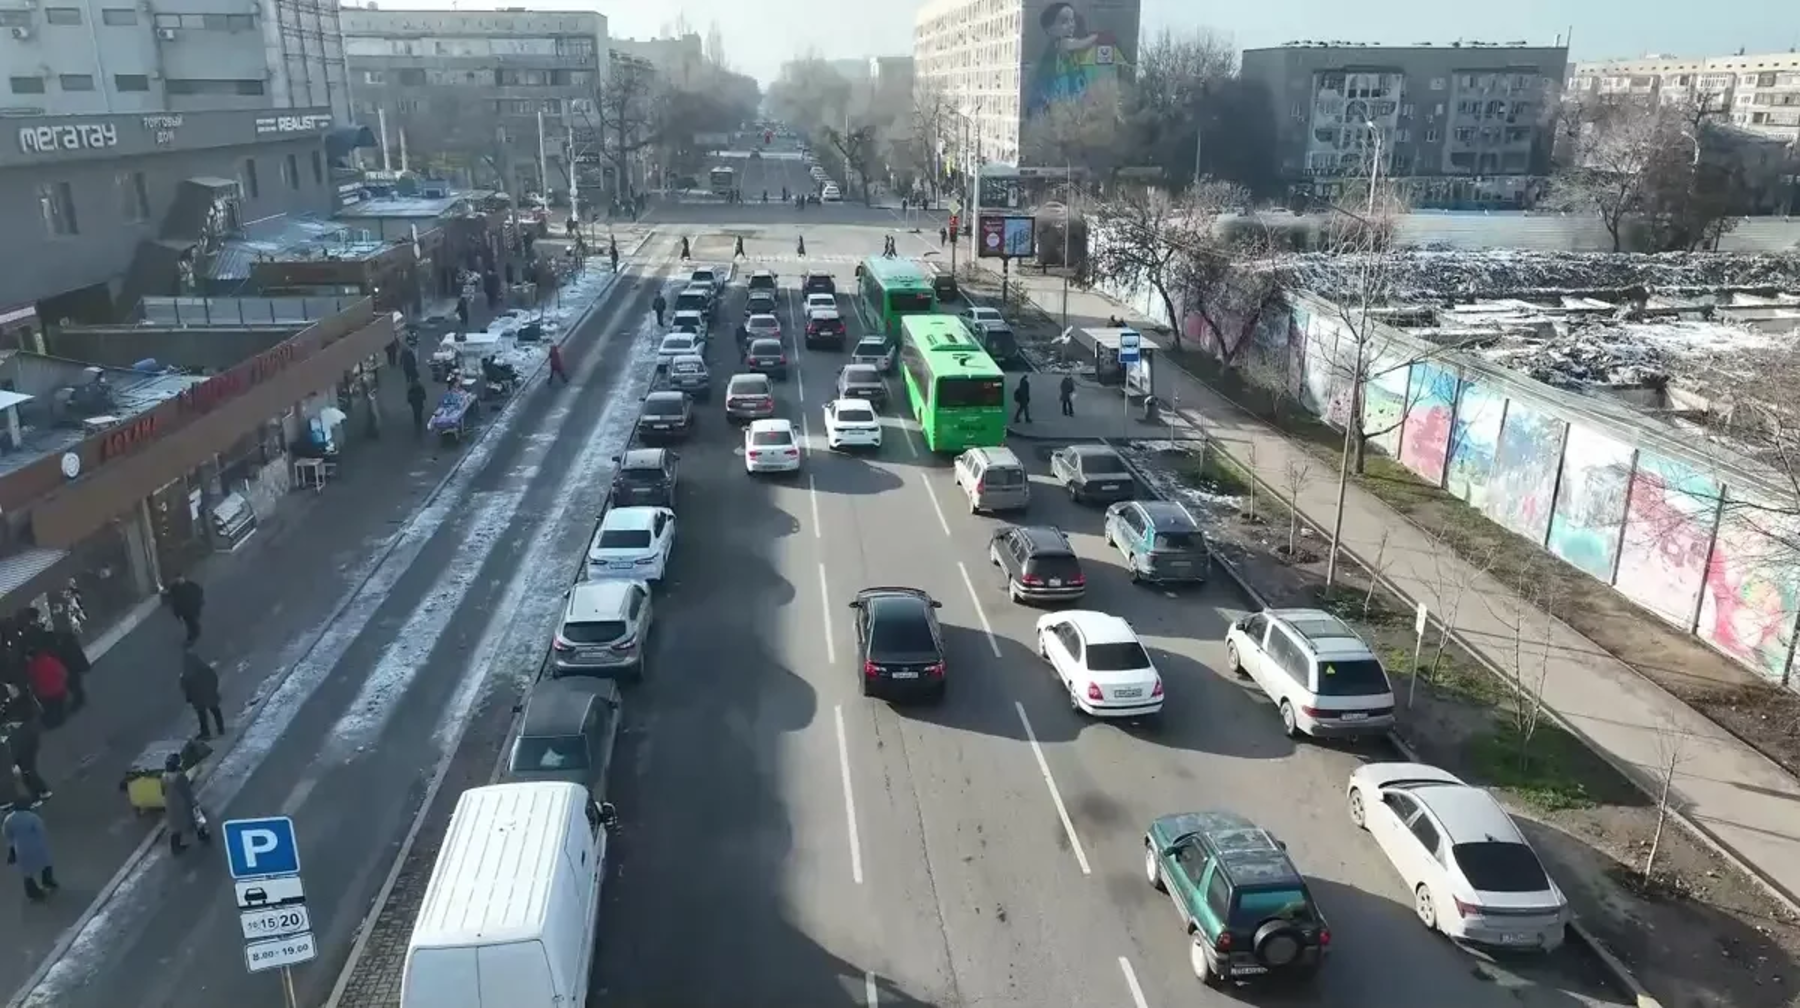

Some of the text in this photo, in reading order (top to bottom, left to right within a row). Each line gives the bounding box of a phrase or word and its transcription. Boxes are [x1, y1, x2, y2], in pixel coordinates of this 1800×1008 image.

[277, 116, 315, 131] REALIST
[241, 829, 278, 868] P
[260, 918, 275, 928] 15
[280, 913, 299, 927] 20
